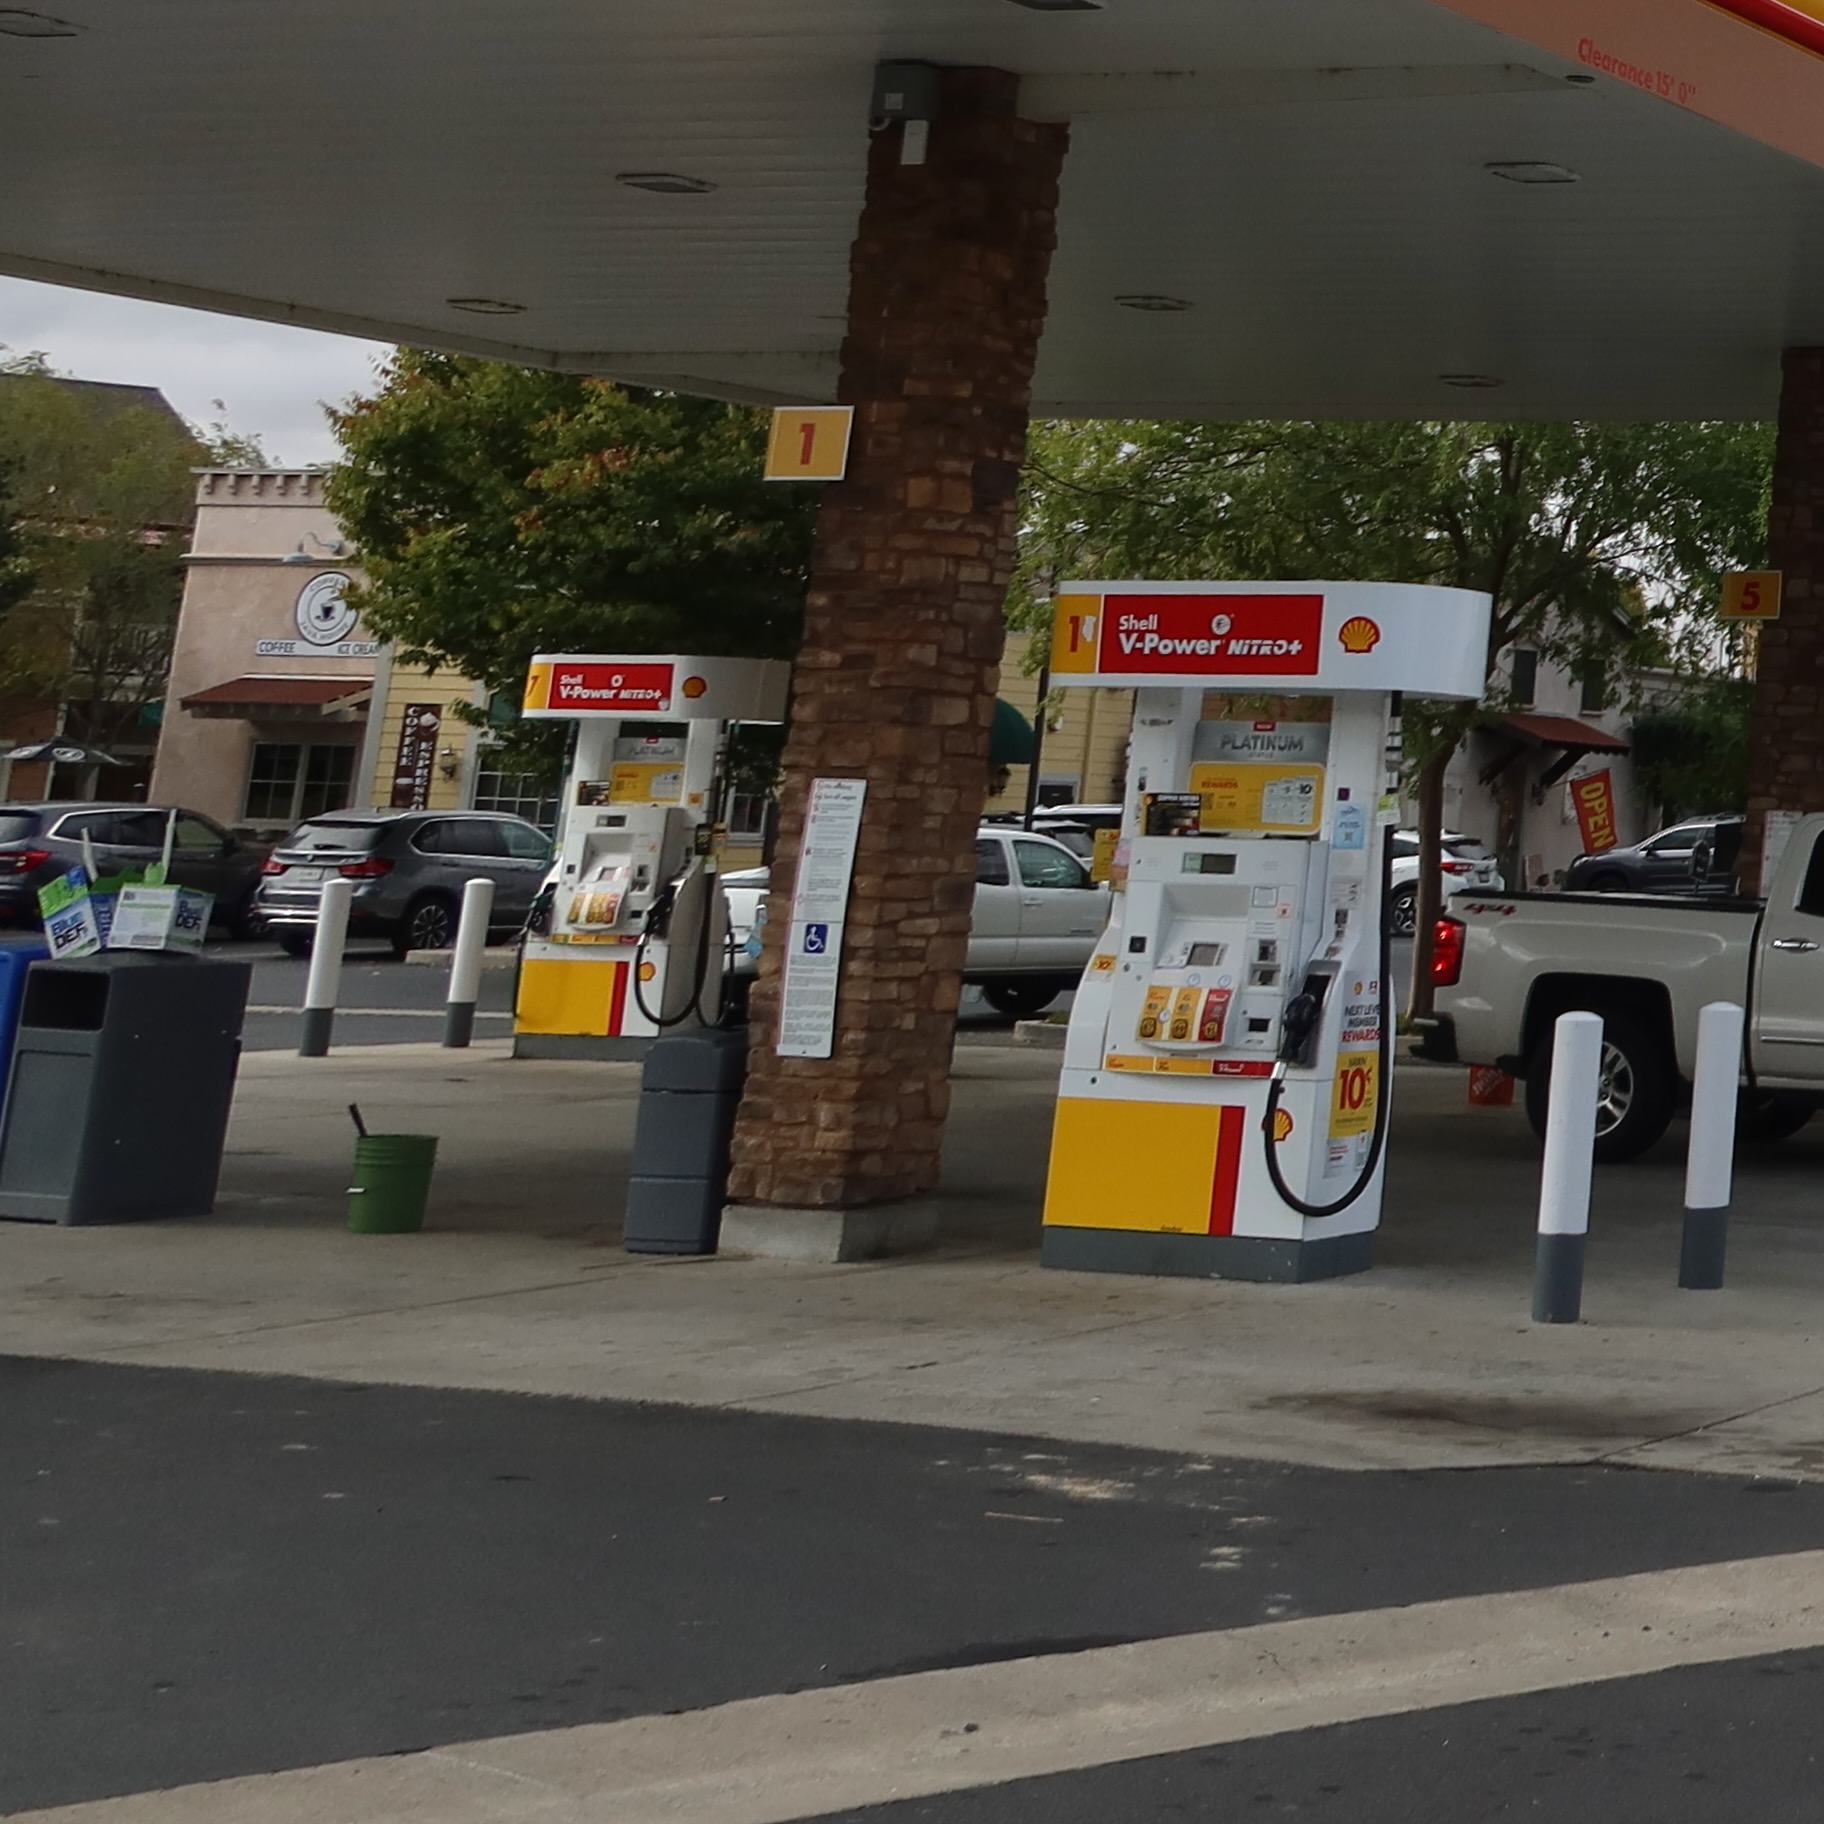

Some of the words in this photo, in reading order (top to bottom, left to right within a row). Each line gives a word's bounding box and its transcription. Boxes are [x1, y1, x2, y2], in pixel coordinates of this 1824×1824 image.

[1578, 38, 1653, 89] Clearance
[799, 423, 816, 465] 1
[1741, 581, 1760, 611] 5
[1118, 614, 1158, 631] Shell
[1069, 615, 1080, 653] 1
[1118, 633, 1221, 656] V-Power
[258, 641, 296, 654] COFFEE
[559, 674, 584, 685] Shell
[559, 686, 616, 699] V-Power
[1220, 733, 1305, 752] PLATINUM
[1580, 782, 1615, 848] OPEN
[1364, 1003, 1381, 1016] LEVE
